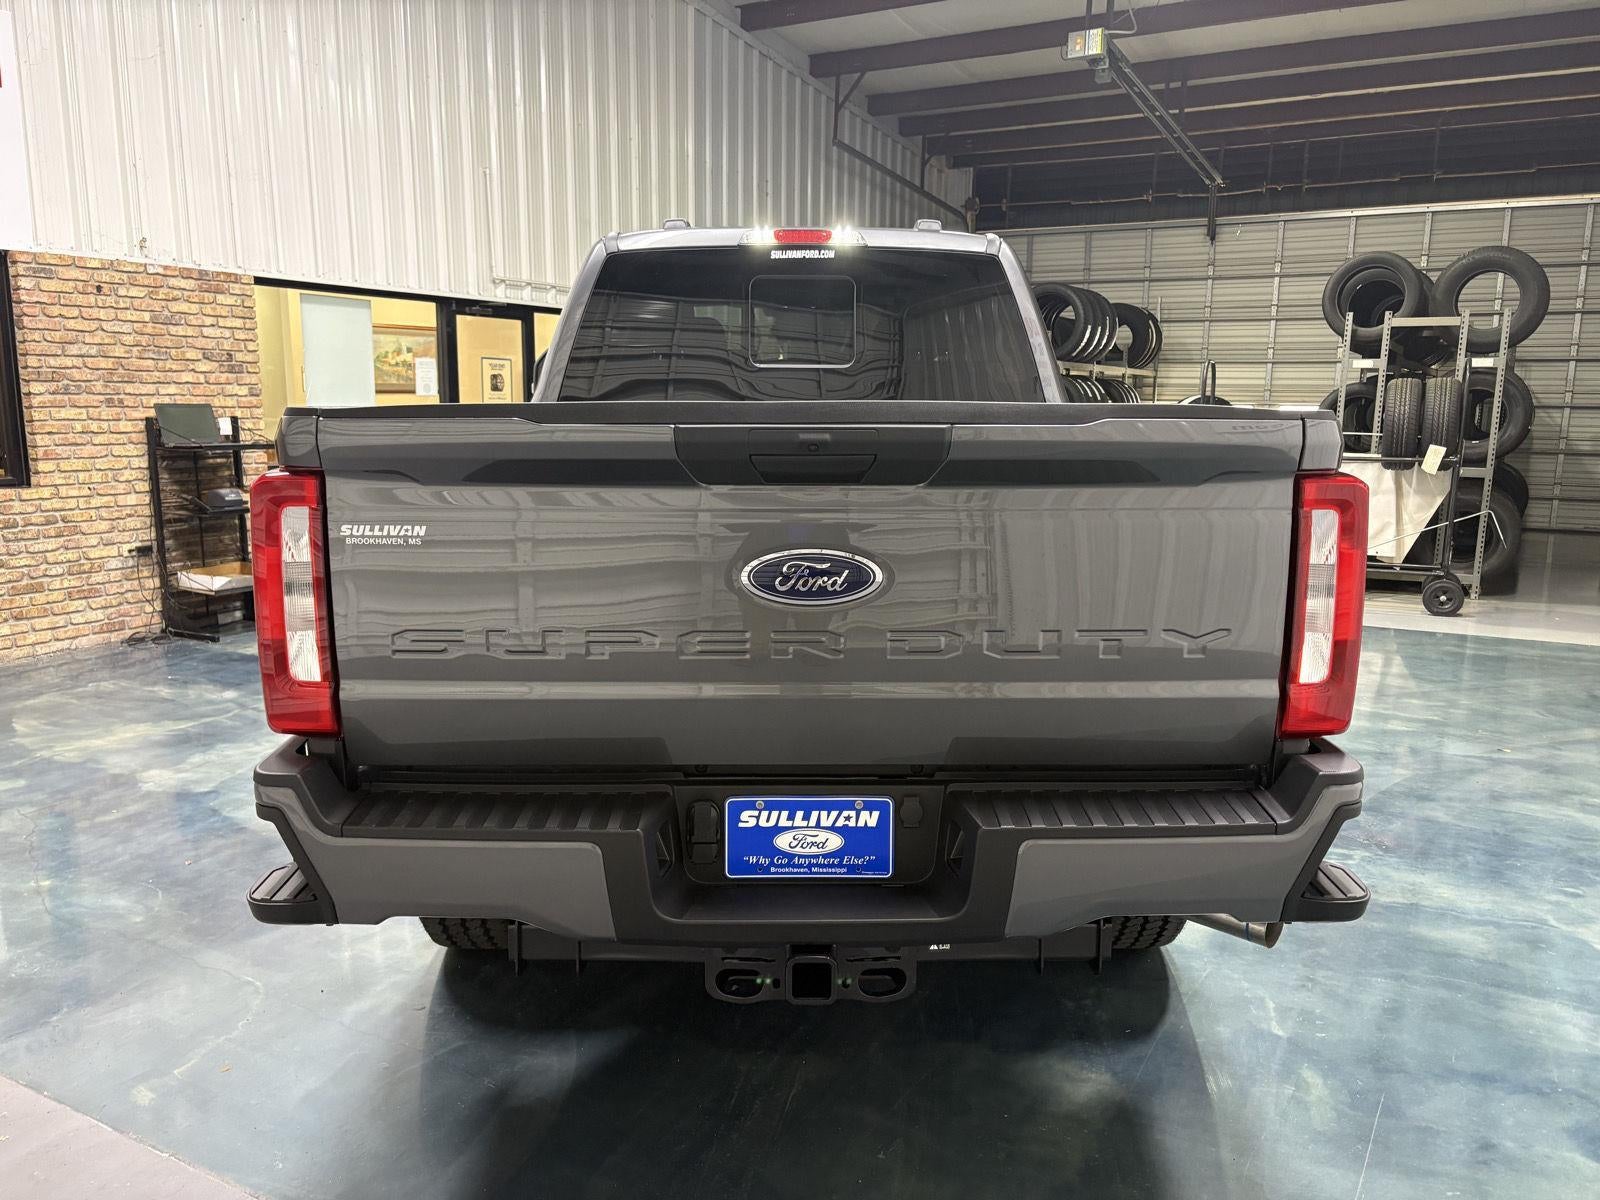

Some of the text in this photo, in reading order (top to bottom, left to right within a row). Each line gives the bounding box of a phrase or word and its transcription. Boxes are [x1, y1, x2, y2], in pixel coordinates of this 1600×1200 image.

[770, 249, 835, 259] SULLIVANFORD.COM
[340, 524, 426, 536] SULLIVAN
[346, 537, 406, 545] BROOKHAVEN,
[774, 561, 850, 592] Ford
[391, 628, 1232, 659] SUPER DUTY
[738, 810, 880, 827] SULLIVAN
[788, 833, 829, 850] Ford
[774, 855, 788, 865] Go
[790, 855, 840, 867] Anywhere
[811, 866, 848, 874] Mississippi
